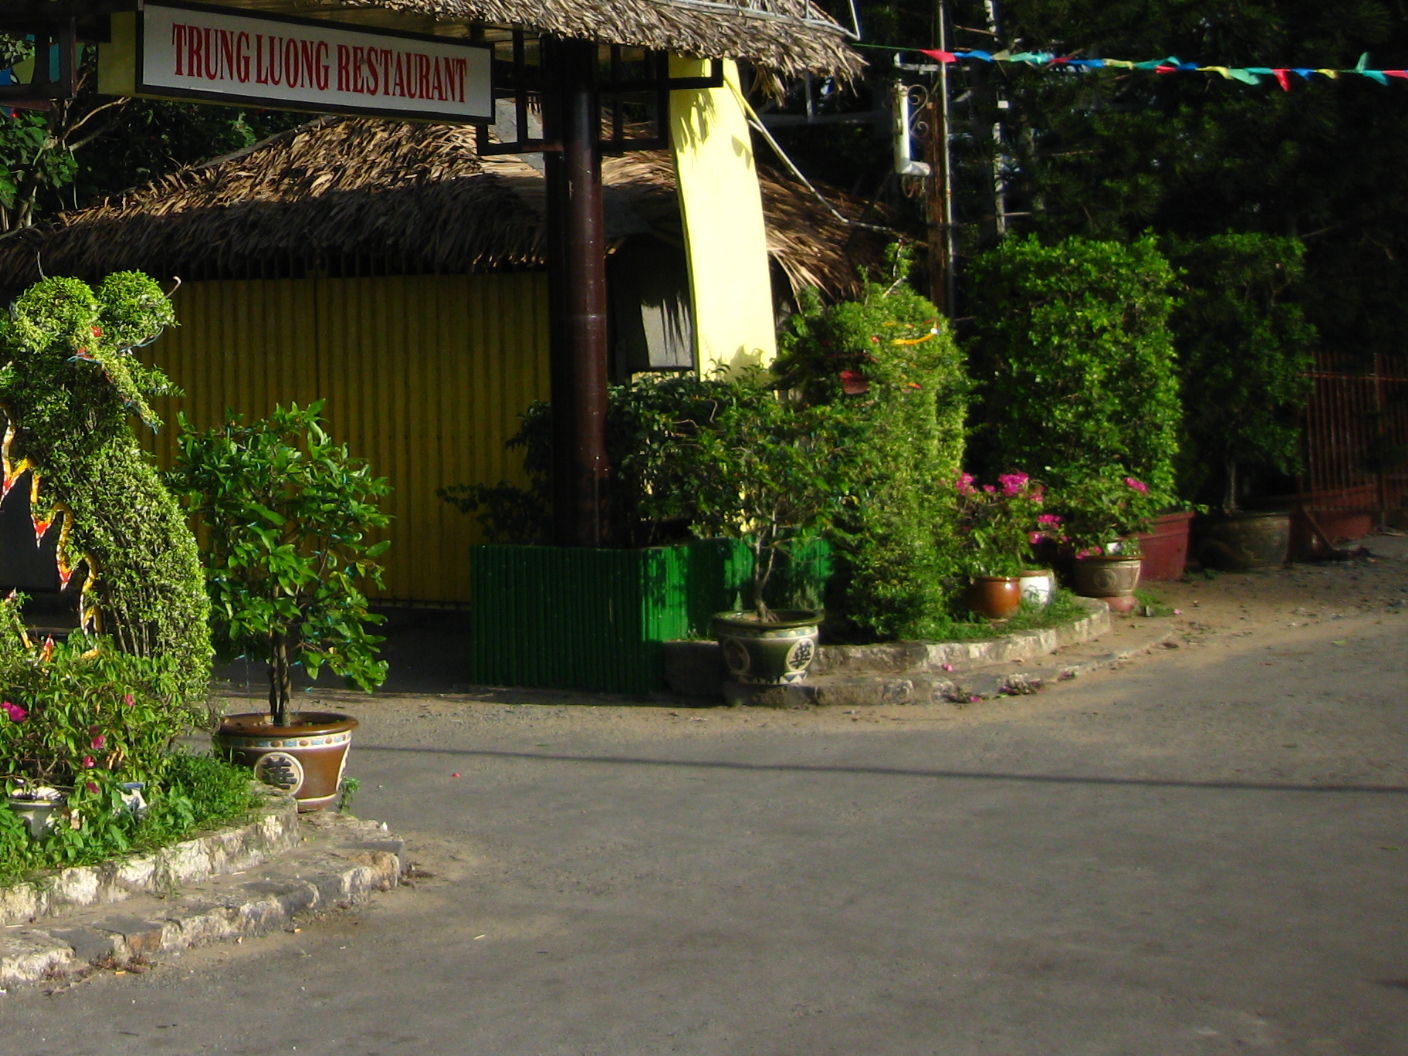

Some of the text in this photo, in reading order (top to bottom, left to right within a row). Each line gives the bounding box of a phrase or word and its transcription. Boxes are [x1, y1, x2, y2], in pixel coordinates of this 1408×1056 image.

[172, 22, 468, 103] TRUNG LUONG RESTAURANT
